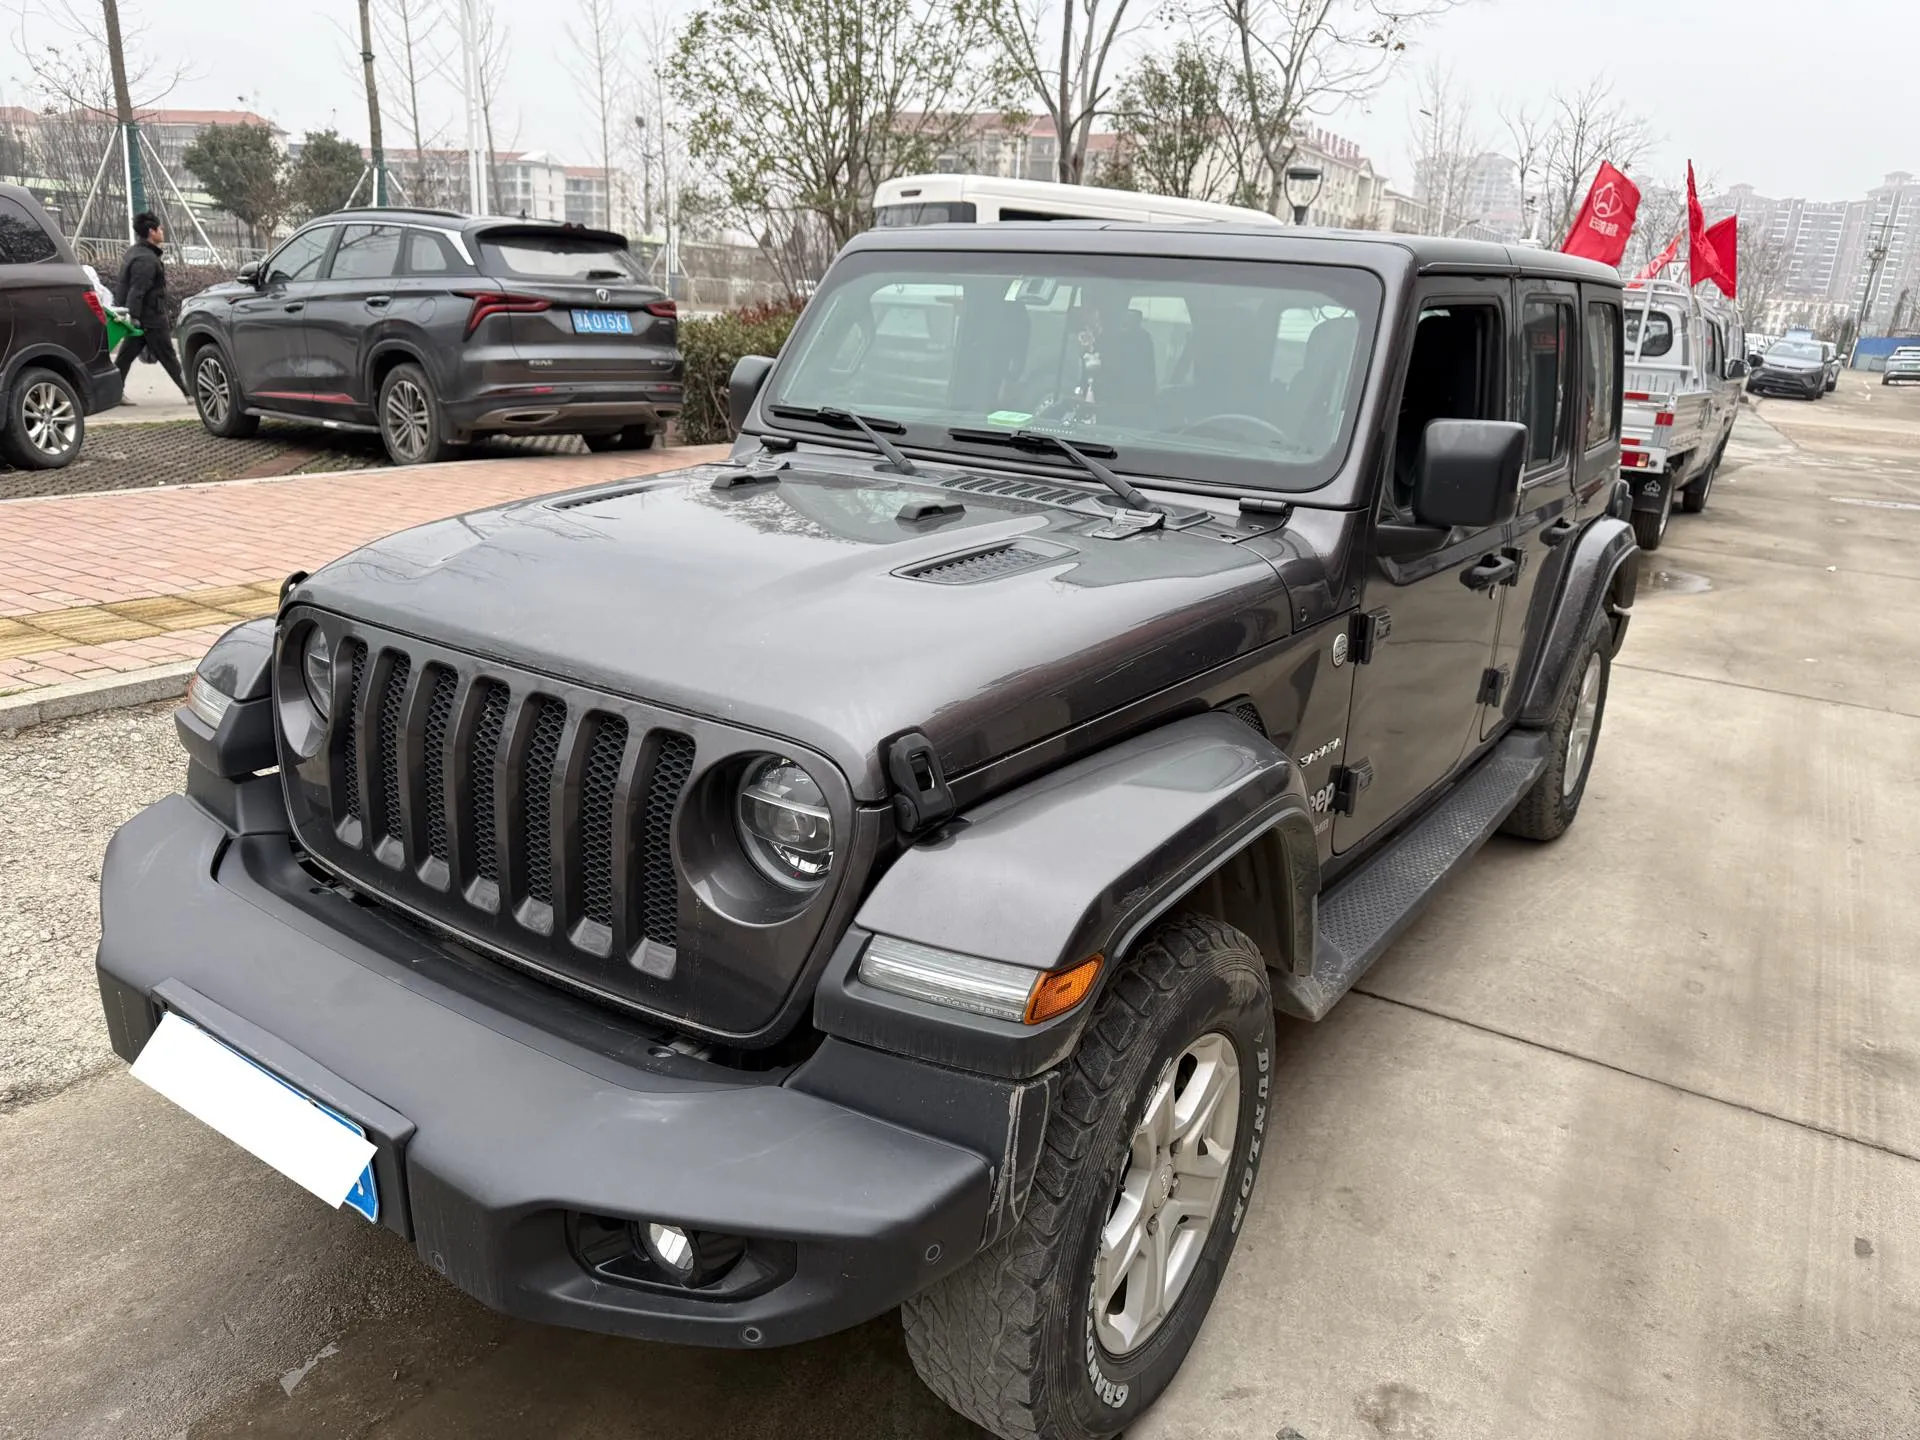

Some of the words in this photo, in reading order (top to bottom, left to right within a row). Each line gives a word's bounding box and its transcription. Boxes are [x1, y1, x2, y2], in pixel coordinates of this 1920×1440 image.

[1299, 737, 1342, 768] SAHARA
[1310, 782, 1335, 813] eep
[1231, 1048, 1269, 1234] DUNLOP
